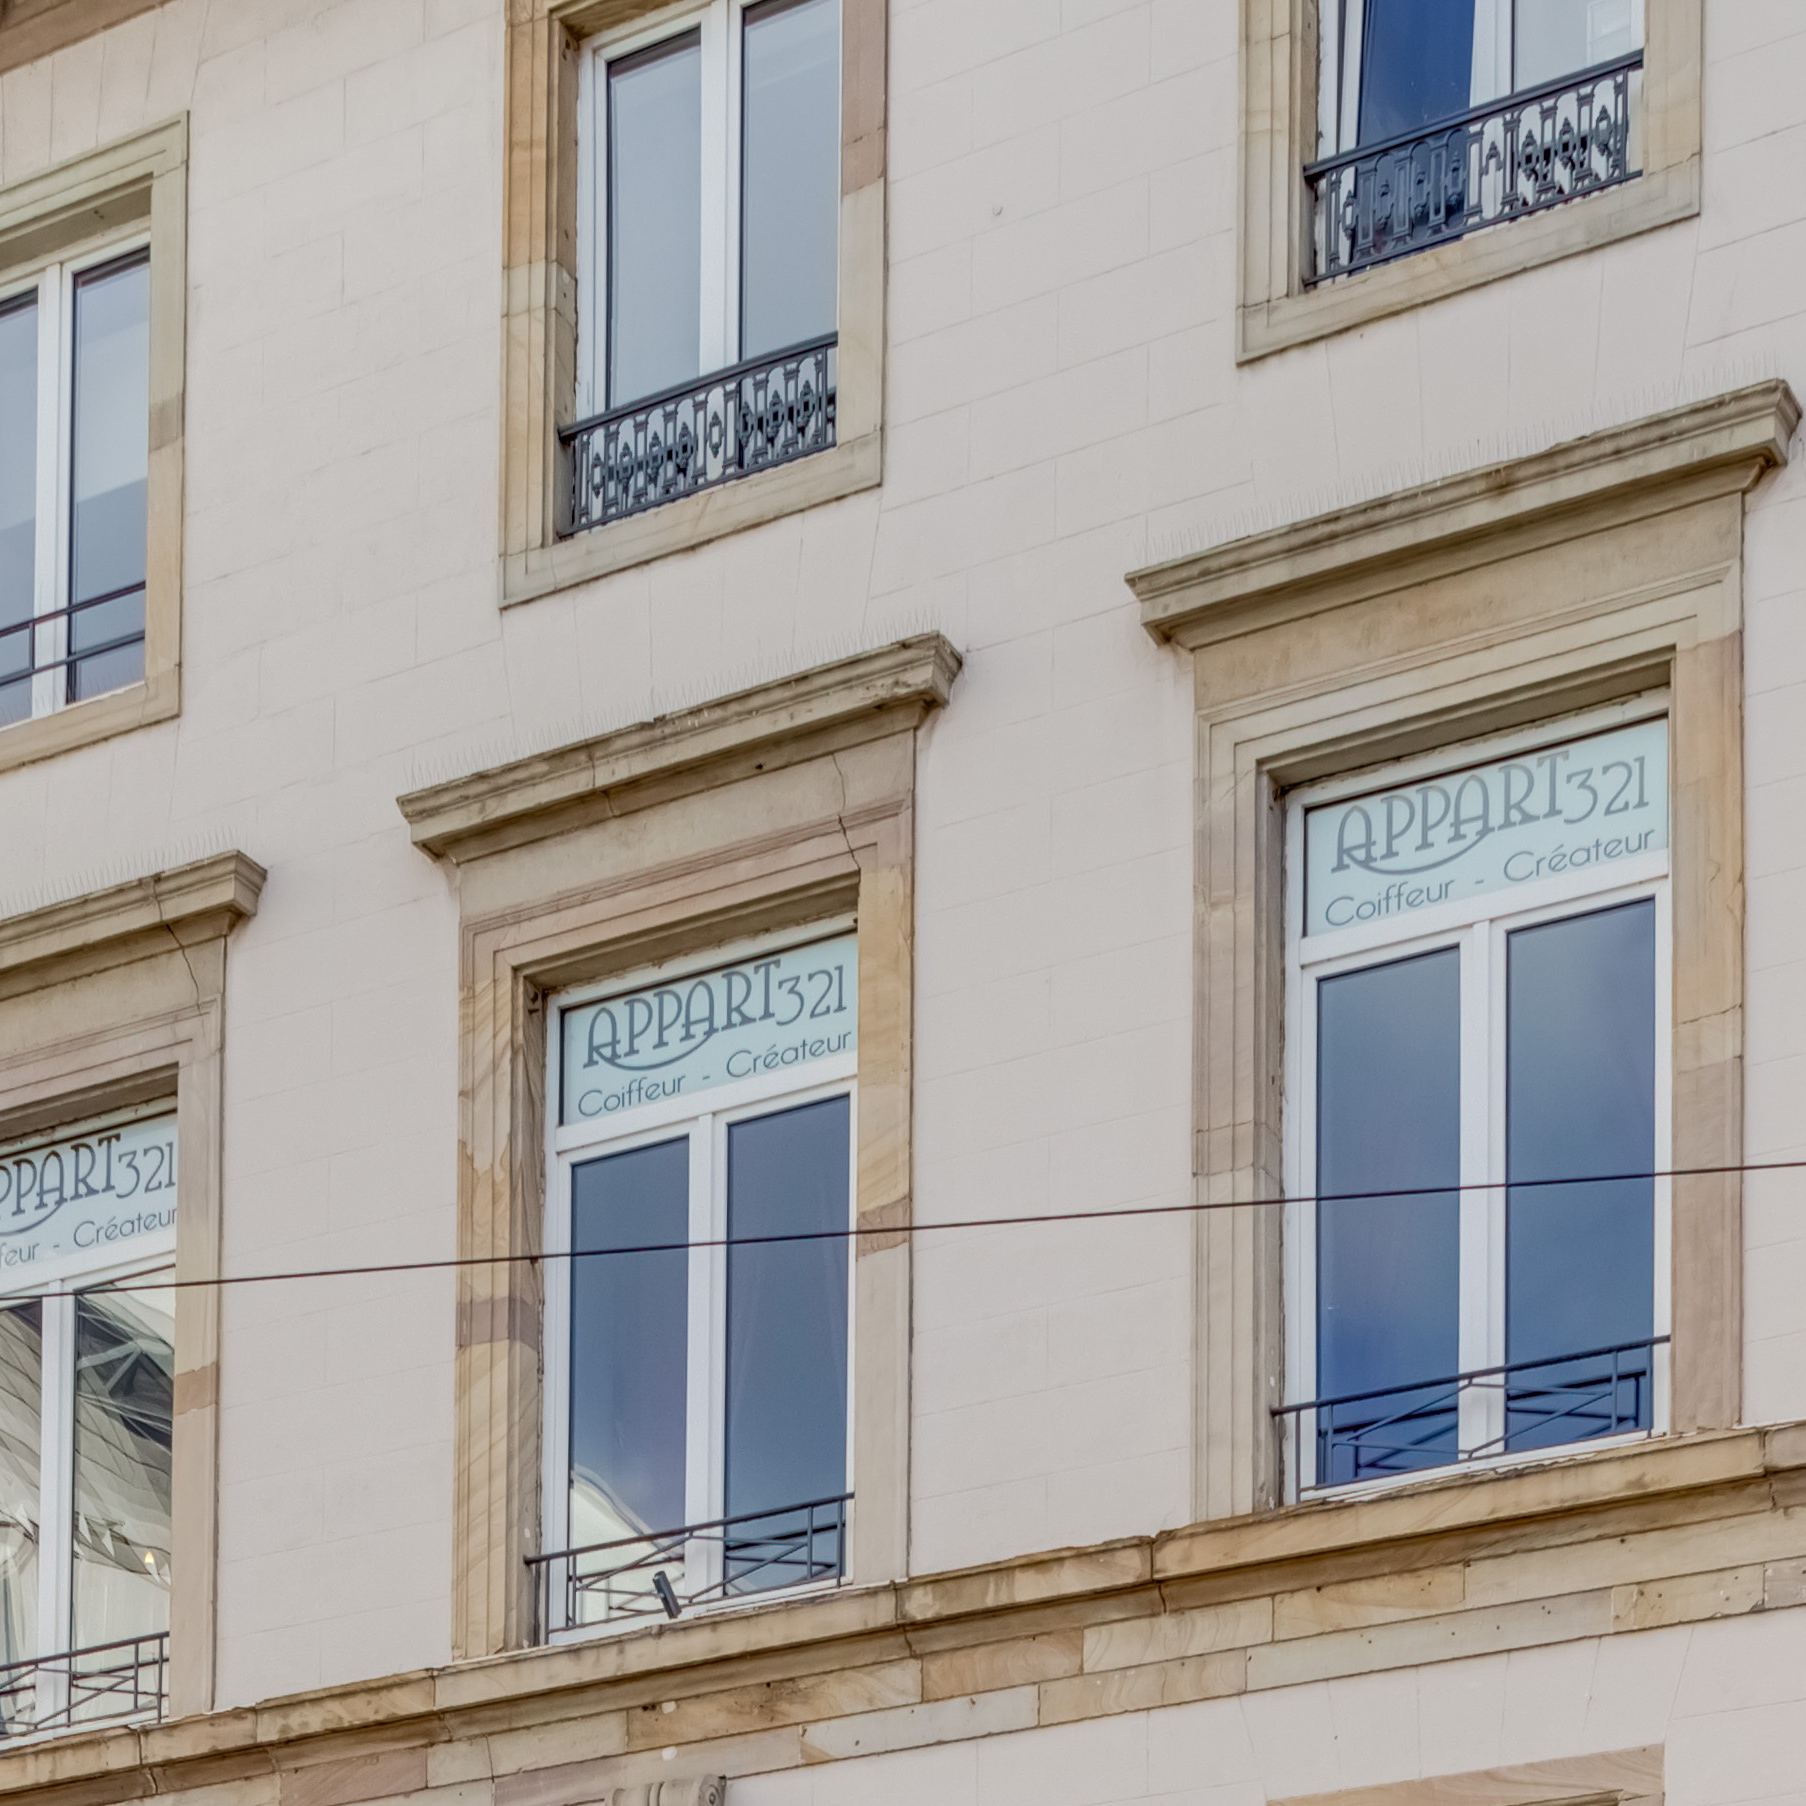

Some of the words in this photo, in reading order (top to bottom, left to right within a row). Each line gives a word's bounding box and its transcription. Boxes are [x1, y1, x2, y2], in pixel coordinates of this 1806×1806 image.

[1326, 880, 1455, 926] Coiffeur
[1504, 829, 1655, 881] Créateur
[578, 1075, 686, 1117] Coiffeur
[727, 1032, 852, 1077] Créateur
